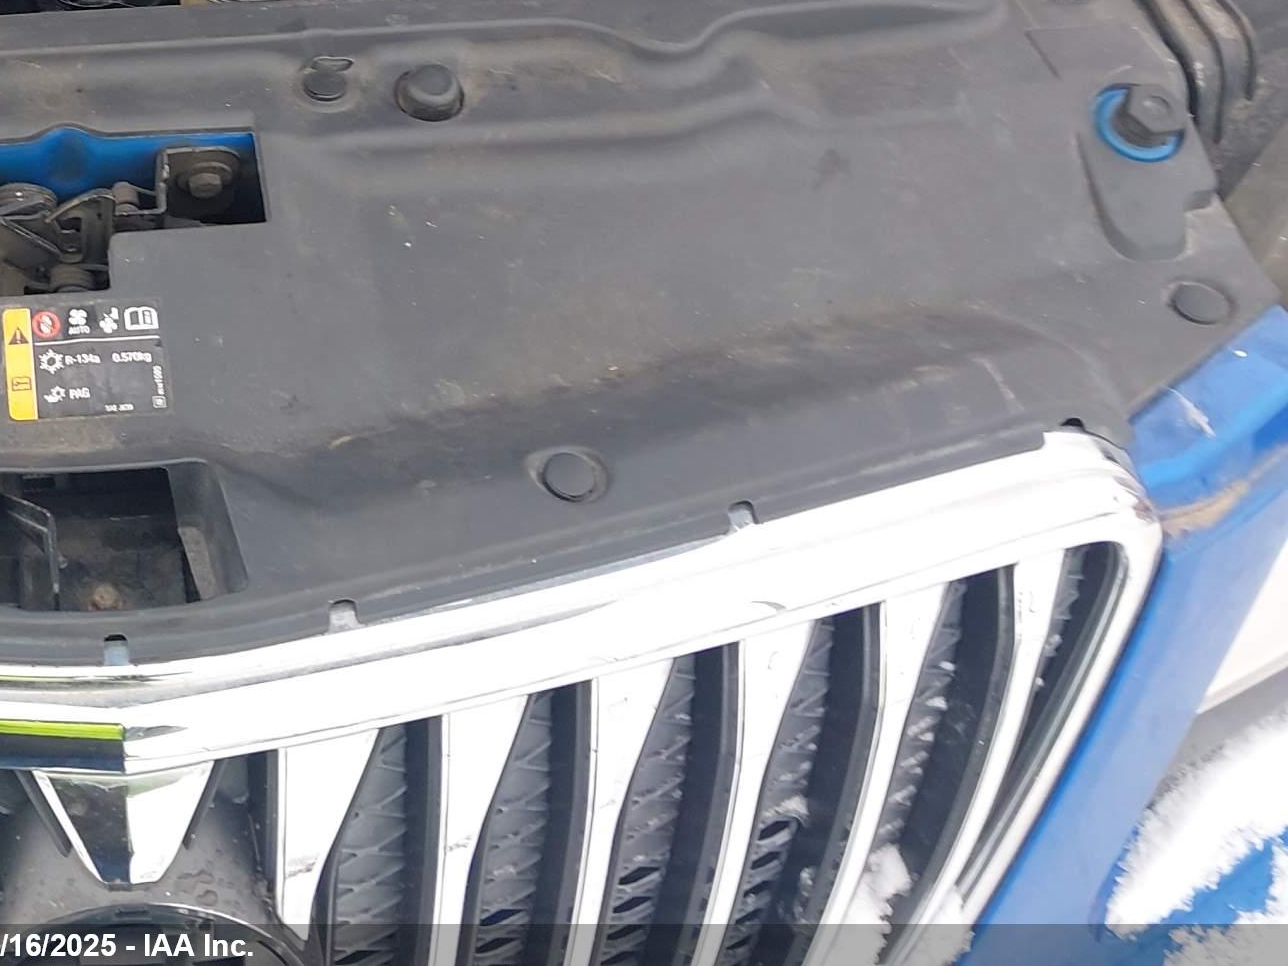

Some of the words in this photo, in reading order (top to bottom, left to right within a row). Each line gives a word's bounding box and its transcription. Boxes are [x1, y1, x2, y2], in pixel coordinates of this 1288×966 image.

[68, 325, 91, 335] AUTO
[64, 353, 101, 365] R-134a
[68, 387, 91, 400] PAG
